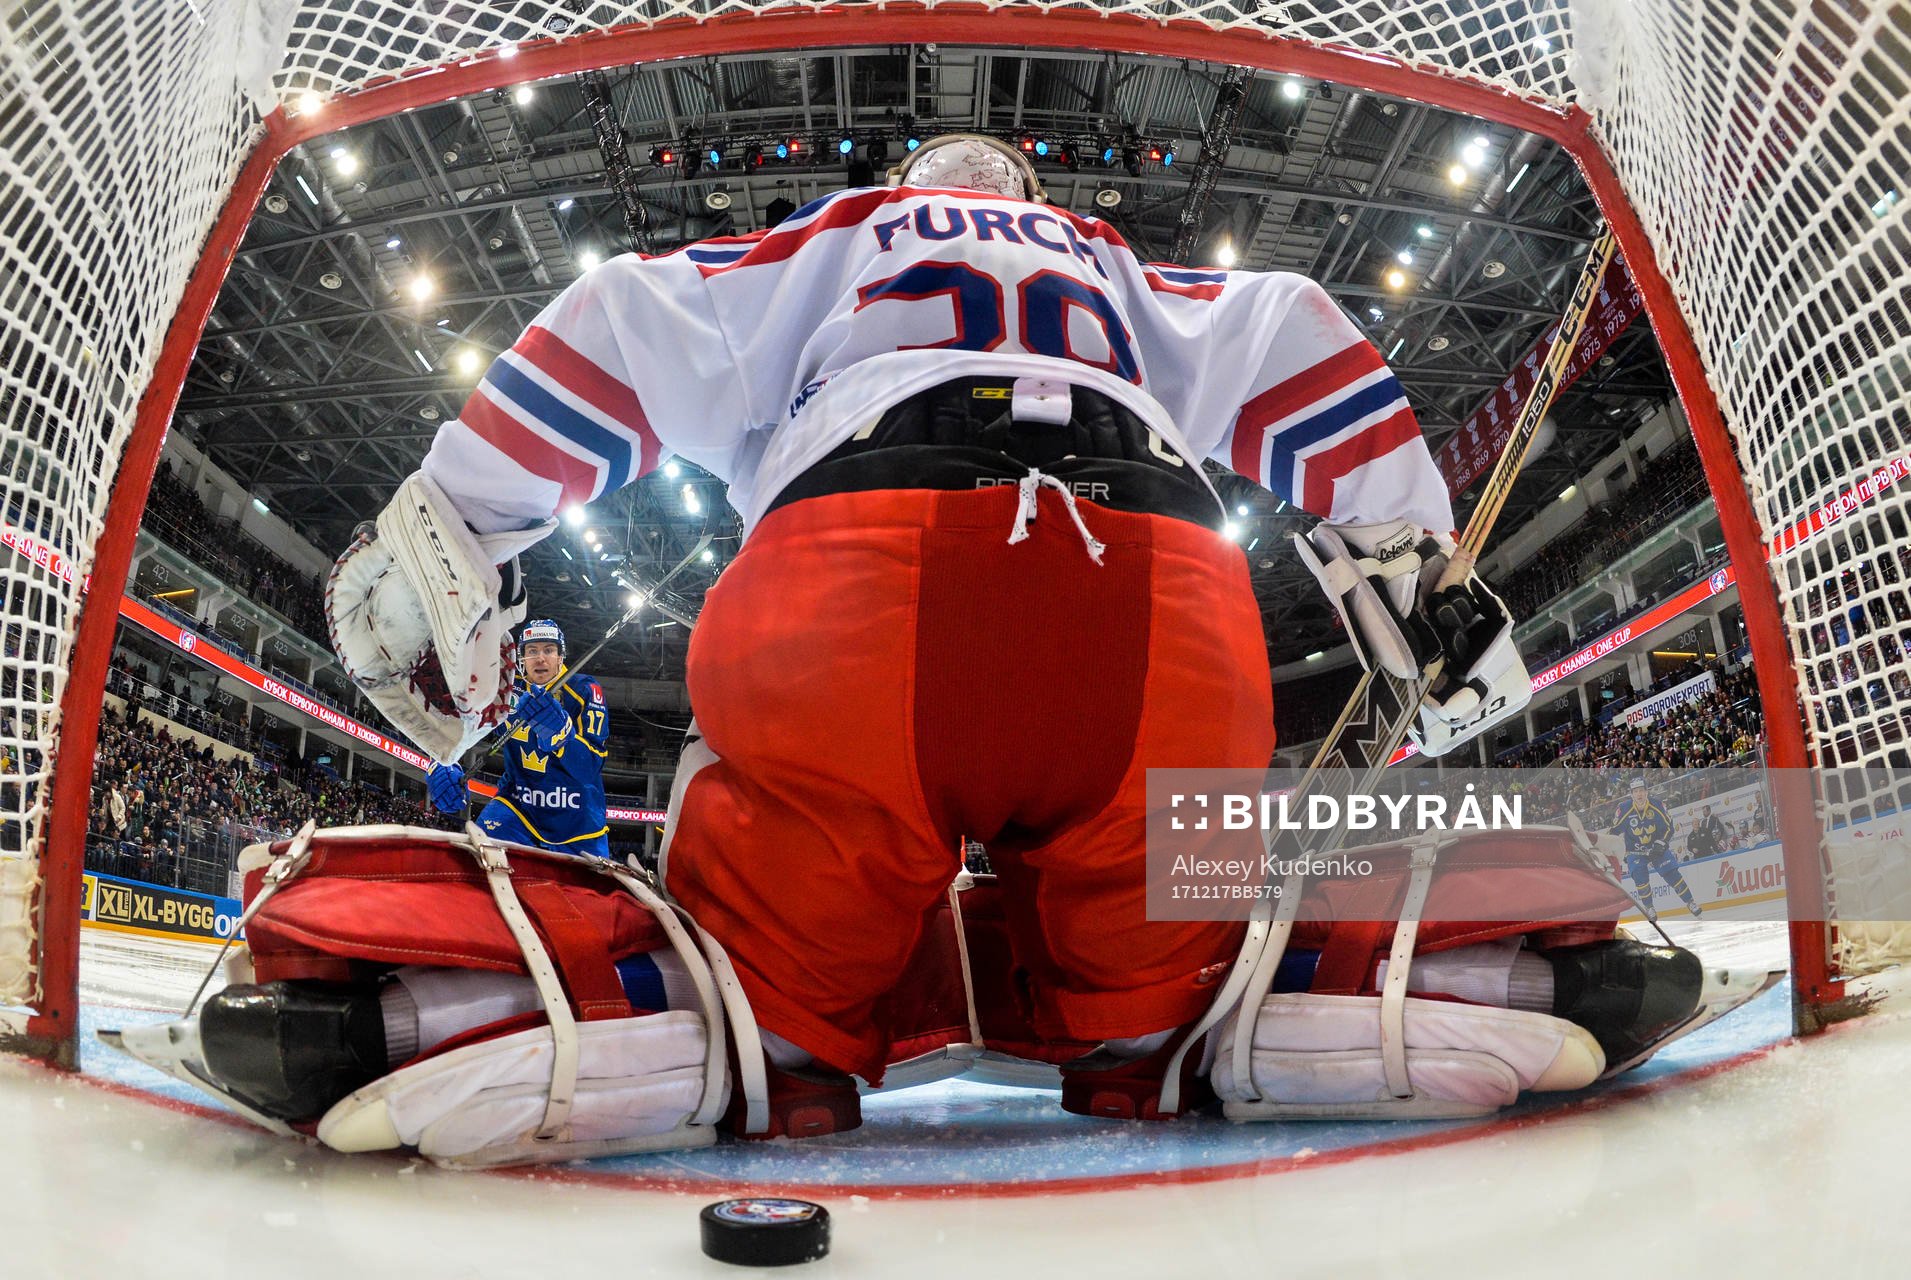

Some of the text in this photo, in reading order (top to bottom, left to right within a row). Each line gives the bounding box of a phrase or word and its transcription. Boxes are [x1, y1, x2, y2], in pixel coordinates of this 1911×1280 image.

[873, 203, 1110, 281] FURCH
[1560, 247, 1605, 345] CCM
[1604, 309, 1627, 338] 1978
[1581, 337, 1601, 365] 1975
[1522, 381, 1550, 439] 1060
[1492, 430, 1510, 453] 1970
[1472, 450, 1489, 471] 1969
[418, 503, 458, 581] CCM
[152, 565, 169, 584] 421
[230, 614, 246, 631] 422
[1678, 629, 1697, 649] 308
[1532, 627, 1631, 691] HOCKEY CHANNEL ONE CUP
[262, 678, 288, 700] КУБОК
[288, 692, 319, 715] ПЕРВОГО
[319, 707, 346, 730] КАНАЛА
[346, 721, 356, 734] ПО
[1626, 678, 1712, 725] ROSOBORONEXPORT
[587, 710, 605, 736] 17
[100, 888, 129, 917] XL
[133, 893, 214, 930] XL-BYGG
